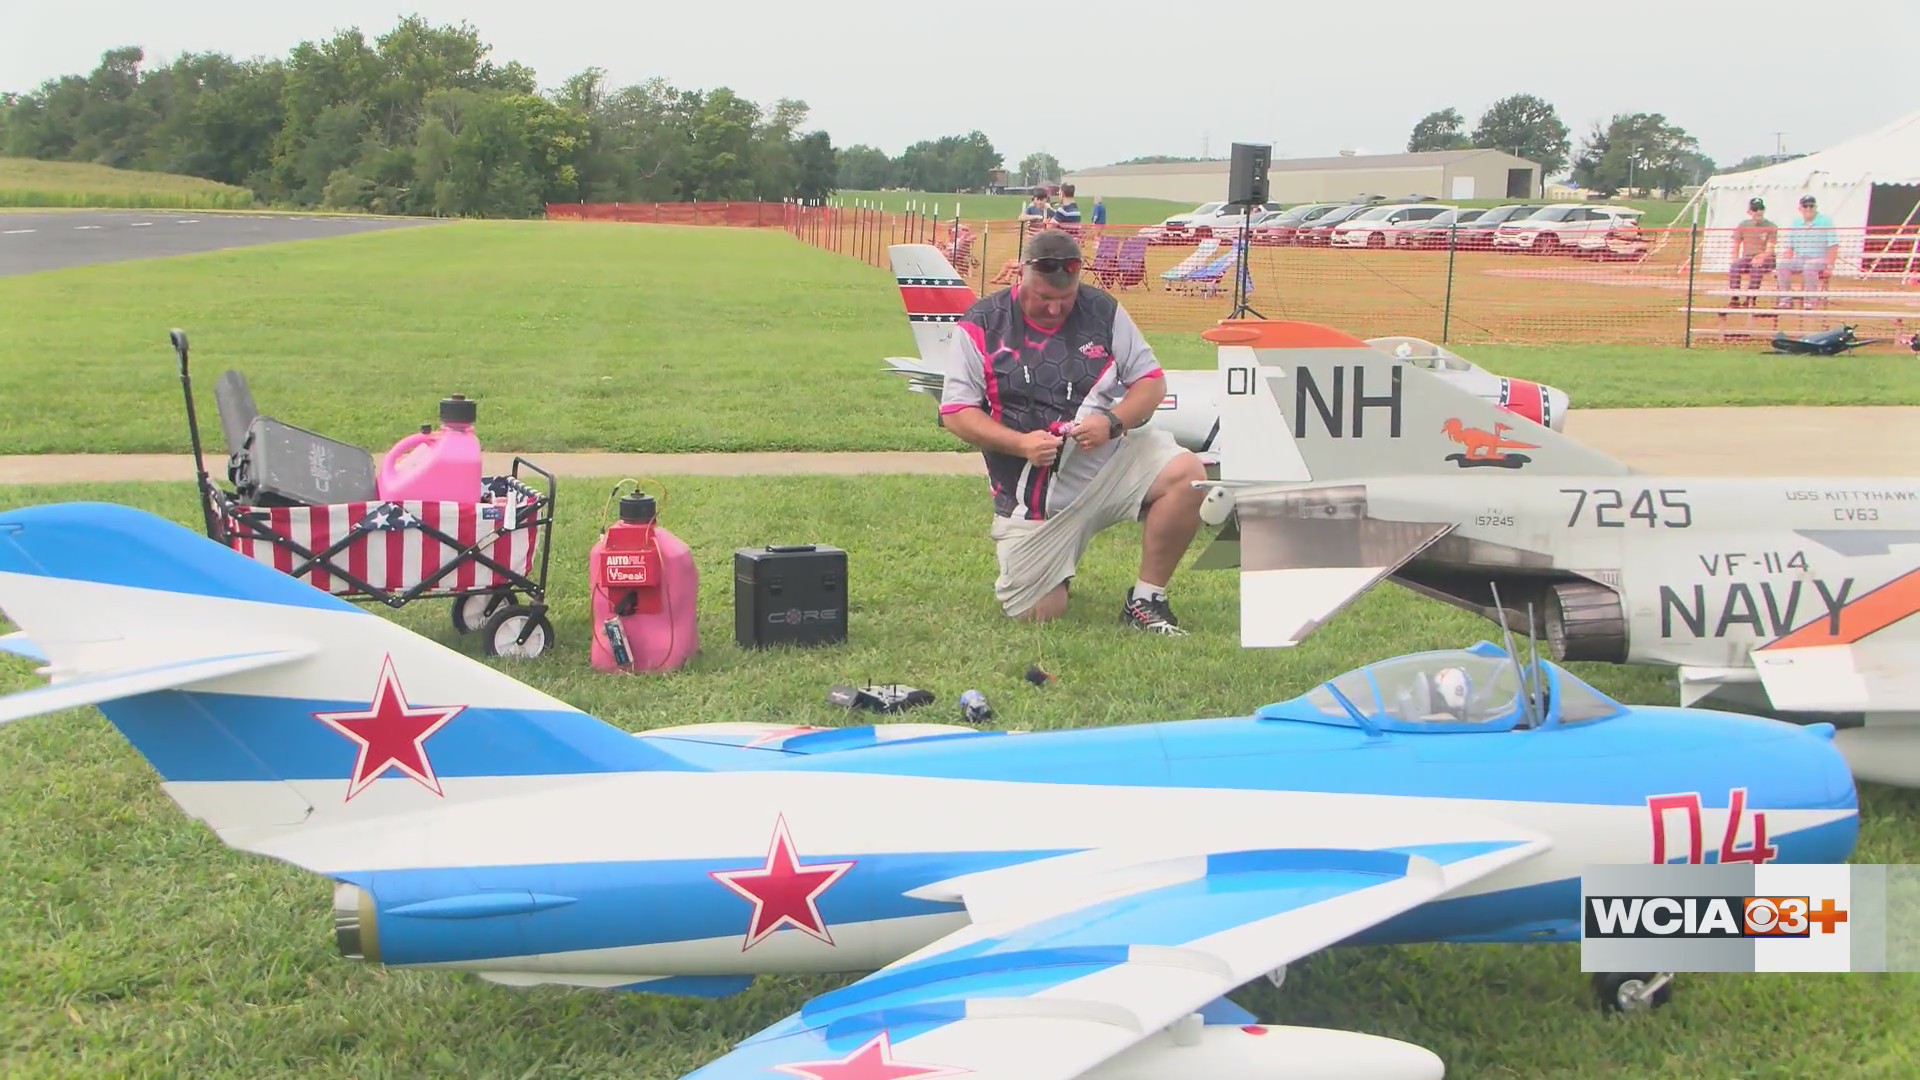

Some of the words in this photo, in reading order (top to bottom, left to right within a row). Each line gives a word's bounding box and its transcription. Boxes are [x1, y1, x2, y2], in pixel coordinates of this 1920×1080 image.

[1295, 365, 1402, 438] NH
[1785, 490, 1820, 501] USS
[1824, 490, 1919, 501] KITTYHAWK
[1559, 489, 1692, 528] 7245
[1833, 507, 1879, 521] CV63
[1475, 515, 1514, 527] 157245
[1699, 551, 1810, 577] VF-114
[768, 608, 838, 624] CORE
[1659, 577, 1855, 638] NAVY
